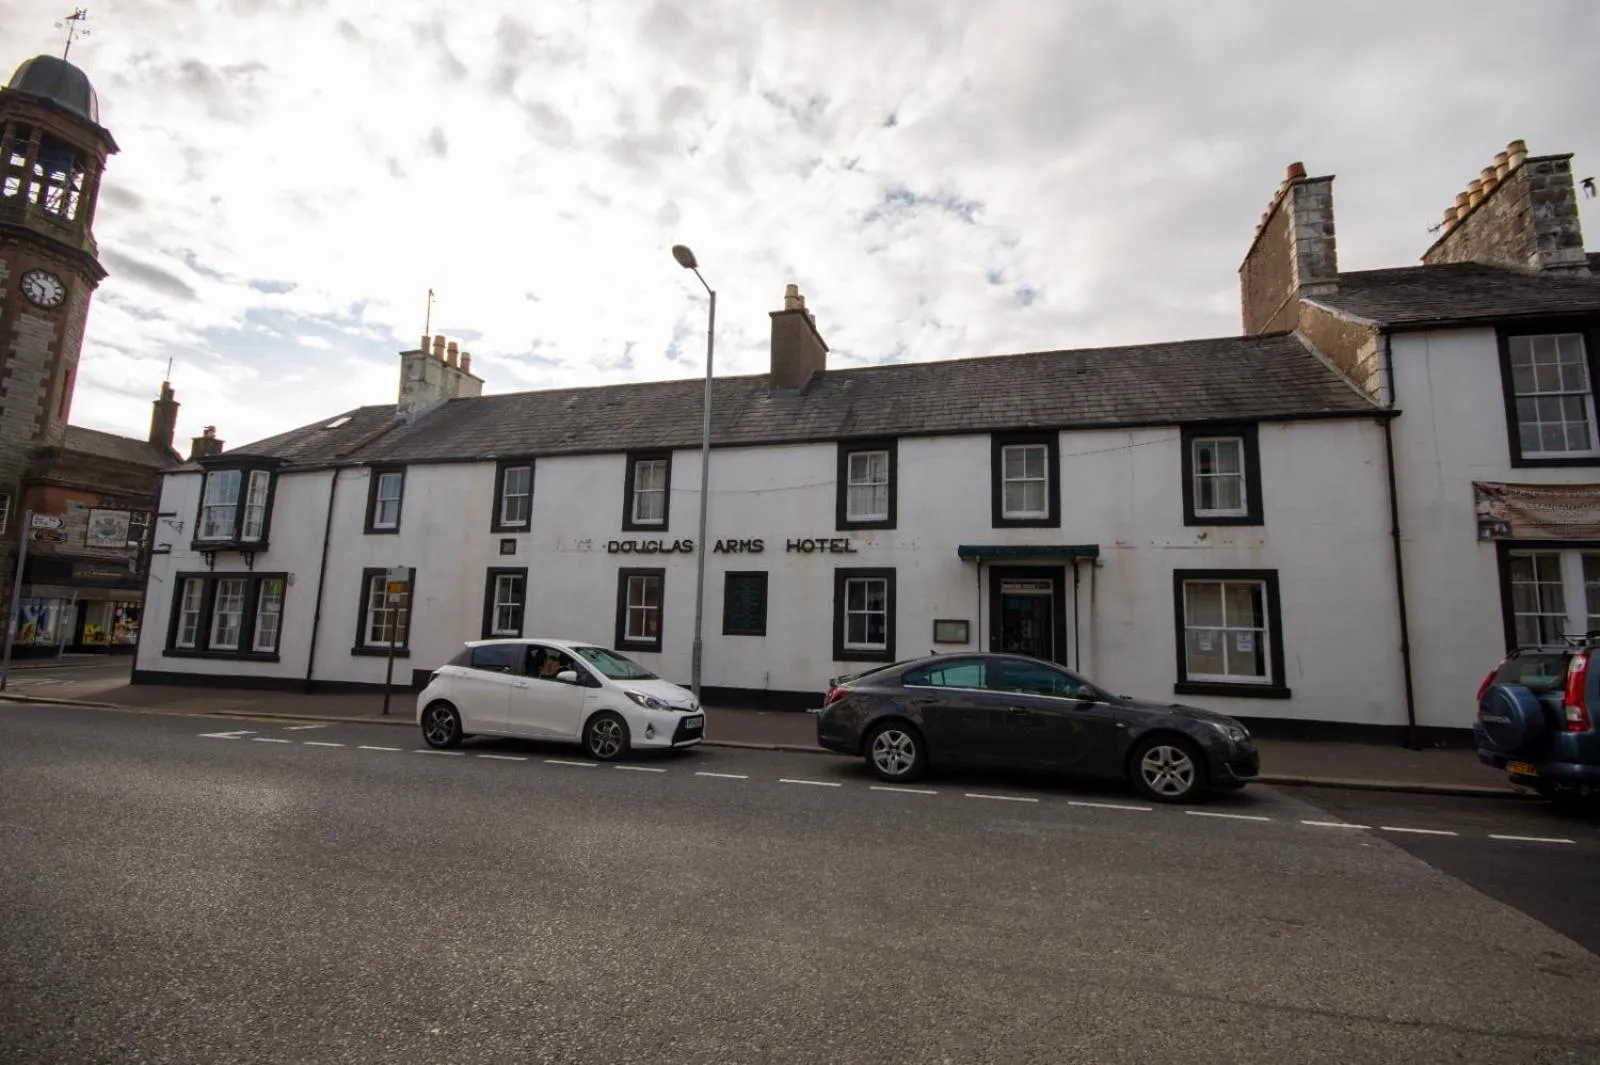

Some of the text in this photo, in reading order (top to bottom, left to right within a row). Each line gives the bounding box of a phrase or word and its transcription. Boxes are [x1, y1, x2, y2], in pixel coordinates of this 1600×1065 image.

[607, 538, 858, 554] DOUGLAS ARMS HOTEL
